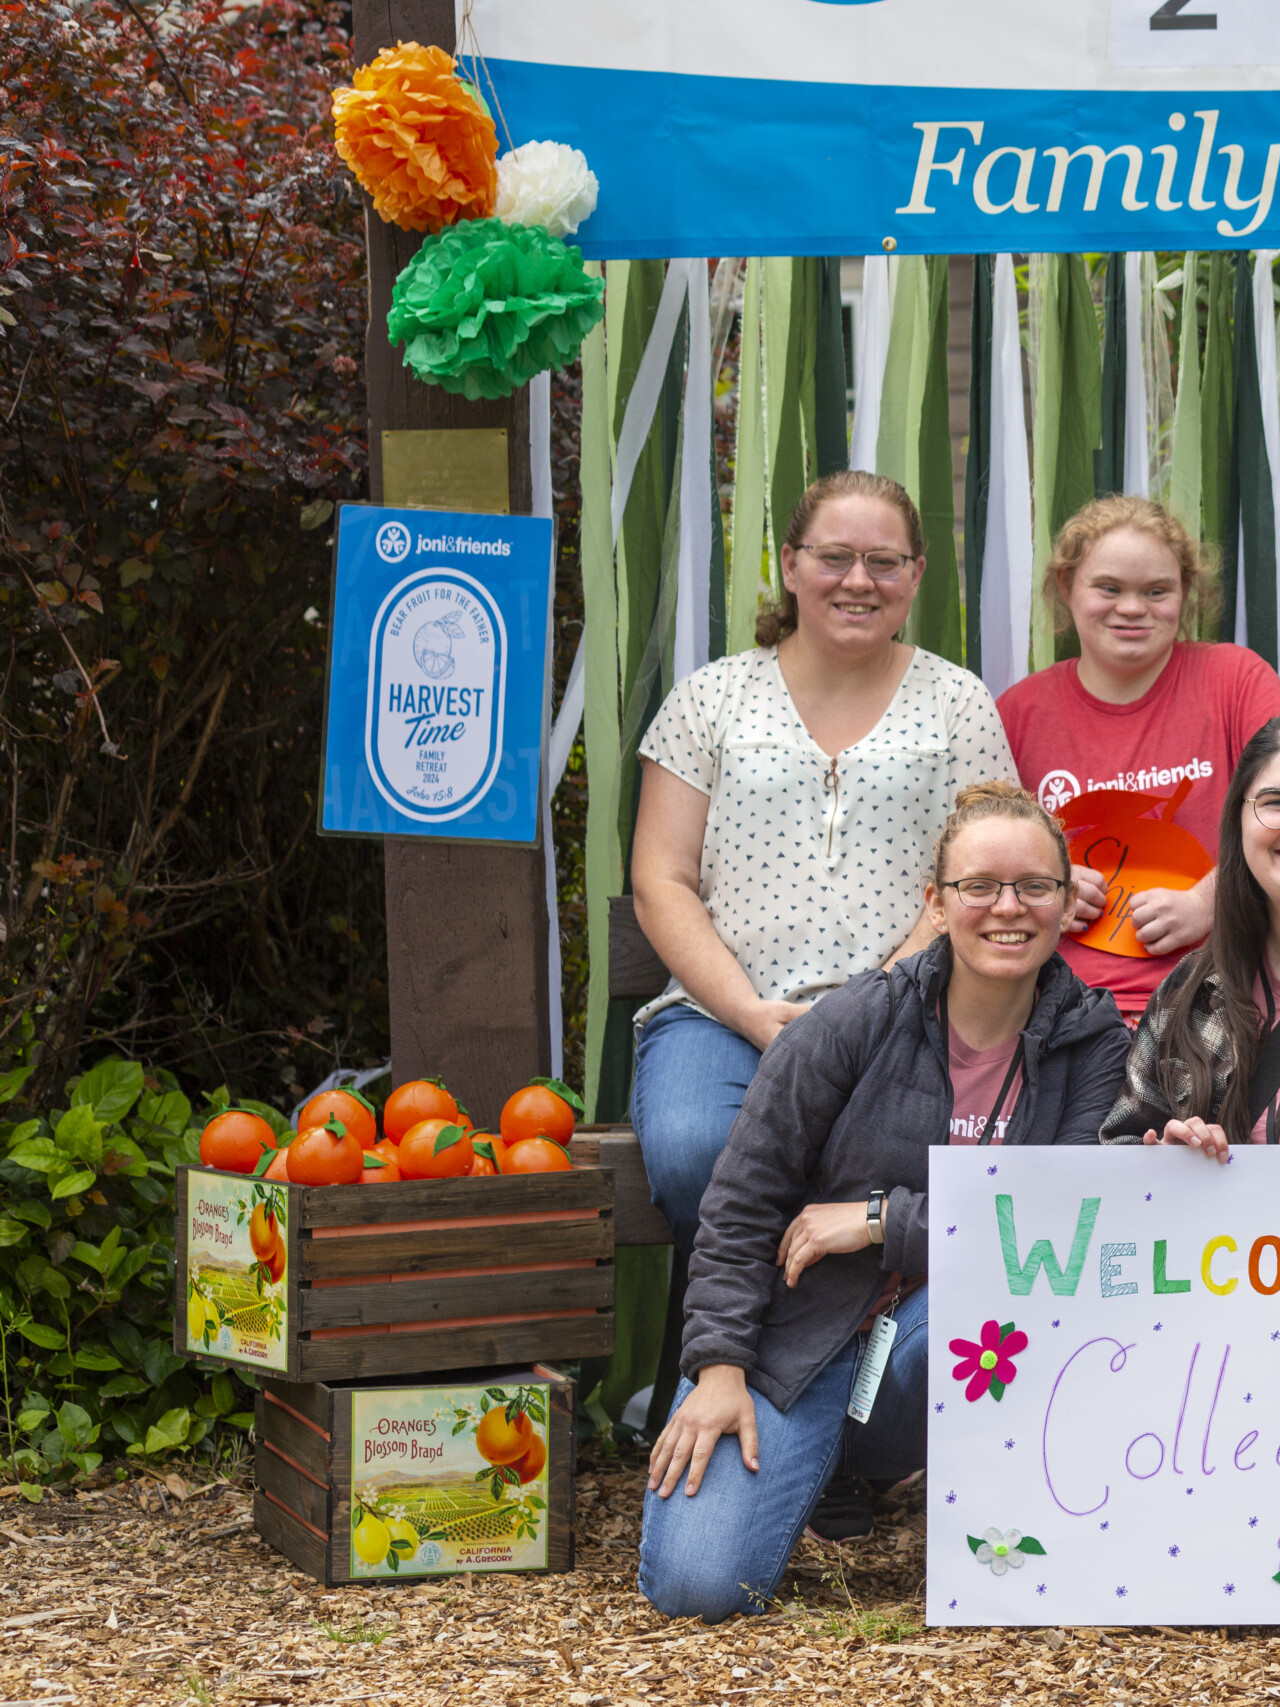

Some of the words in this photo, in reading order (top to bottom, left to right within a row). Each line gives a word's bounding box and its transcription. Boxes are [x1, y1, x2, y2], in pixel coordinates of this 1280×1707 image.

[415, 534, 511, 556] joni&friends
[390, 609, 408, 637] BEAR
[405, 589, 431, 612] FRUIT
[434, 588, 452, 601] FOR
[455, 592, 471, 610] THE
[469, 606, 490, 644] FATHER
[389, 683, 485, 718] HARVEST
[404, 713, 467, 749] Time
[419, 749, 445, 761] FAMILY
[415, 761, 448, 773] RETREAT
[422, 773, 440, 784] 2024
[406, 785, 430, 801] John
[432, 786, 453, 801] 15:8
[195, 1198, 230, 1223] ORANGES
[192, 1217, 214, 1241] Blossom
[215, 1223, 234, 1250] Brand
[240, 1338, 267, 1350] CALIFORNIA
[369, 1418, 437, 1436] ORANGES
[364, 1439, 408, 1464] Blossom
[411, 1439, 444, 1464] Brand
[459, 1546, 512, 1556] CALIFORNIA
